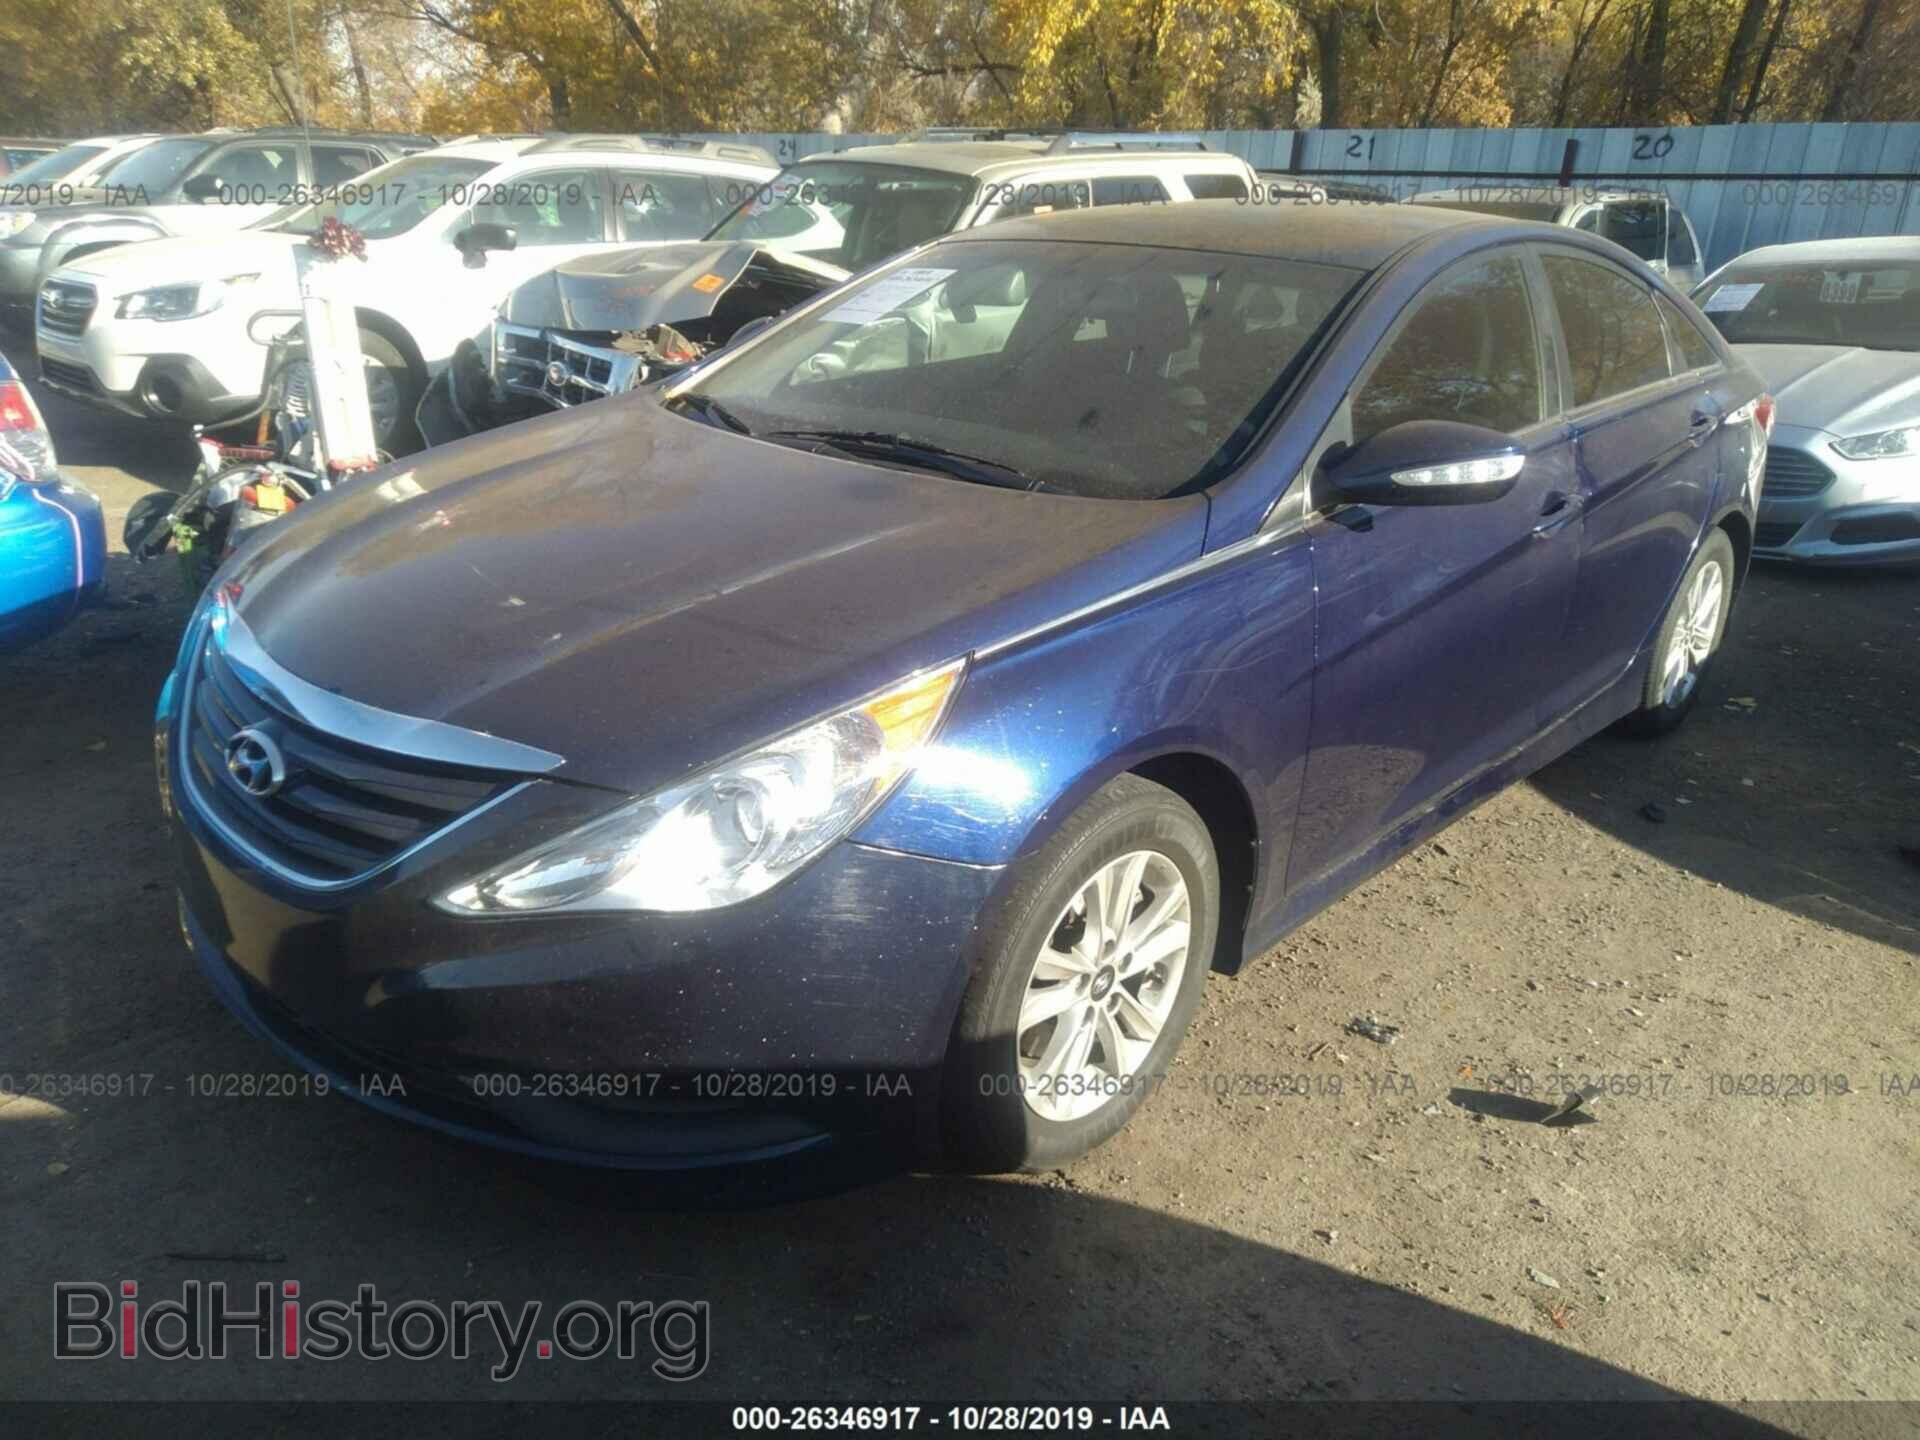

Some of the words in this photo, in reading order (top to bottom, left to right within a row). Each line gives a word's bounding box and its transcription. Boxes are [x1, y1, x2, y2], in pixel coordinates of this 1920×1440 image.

[779, 137, 797, 158] 24
[1346, 136, 1375, 160] 21
[1633, 134, 1674, 160] 20
